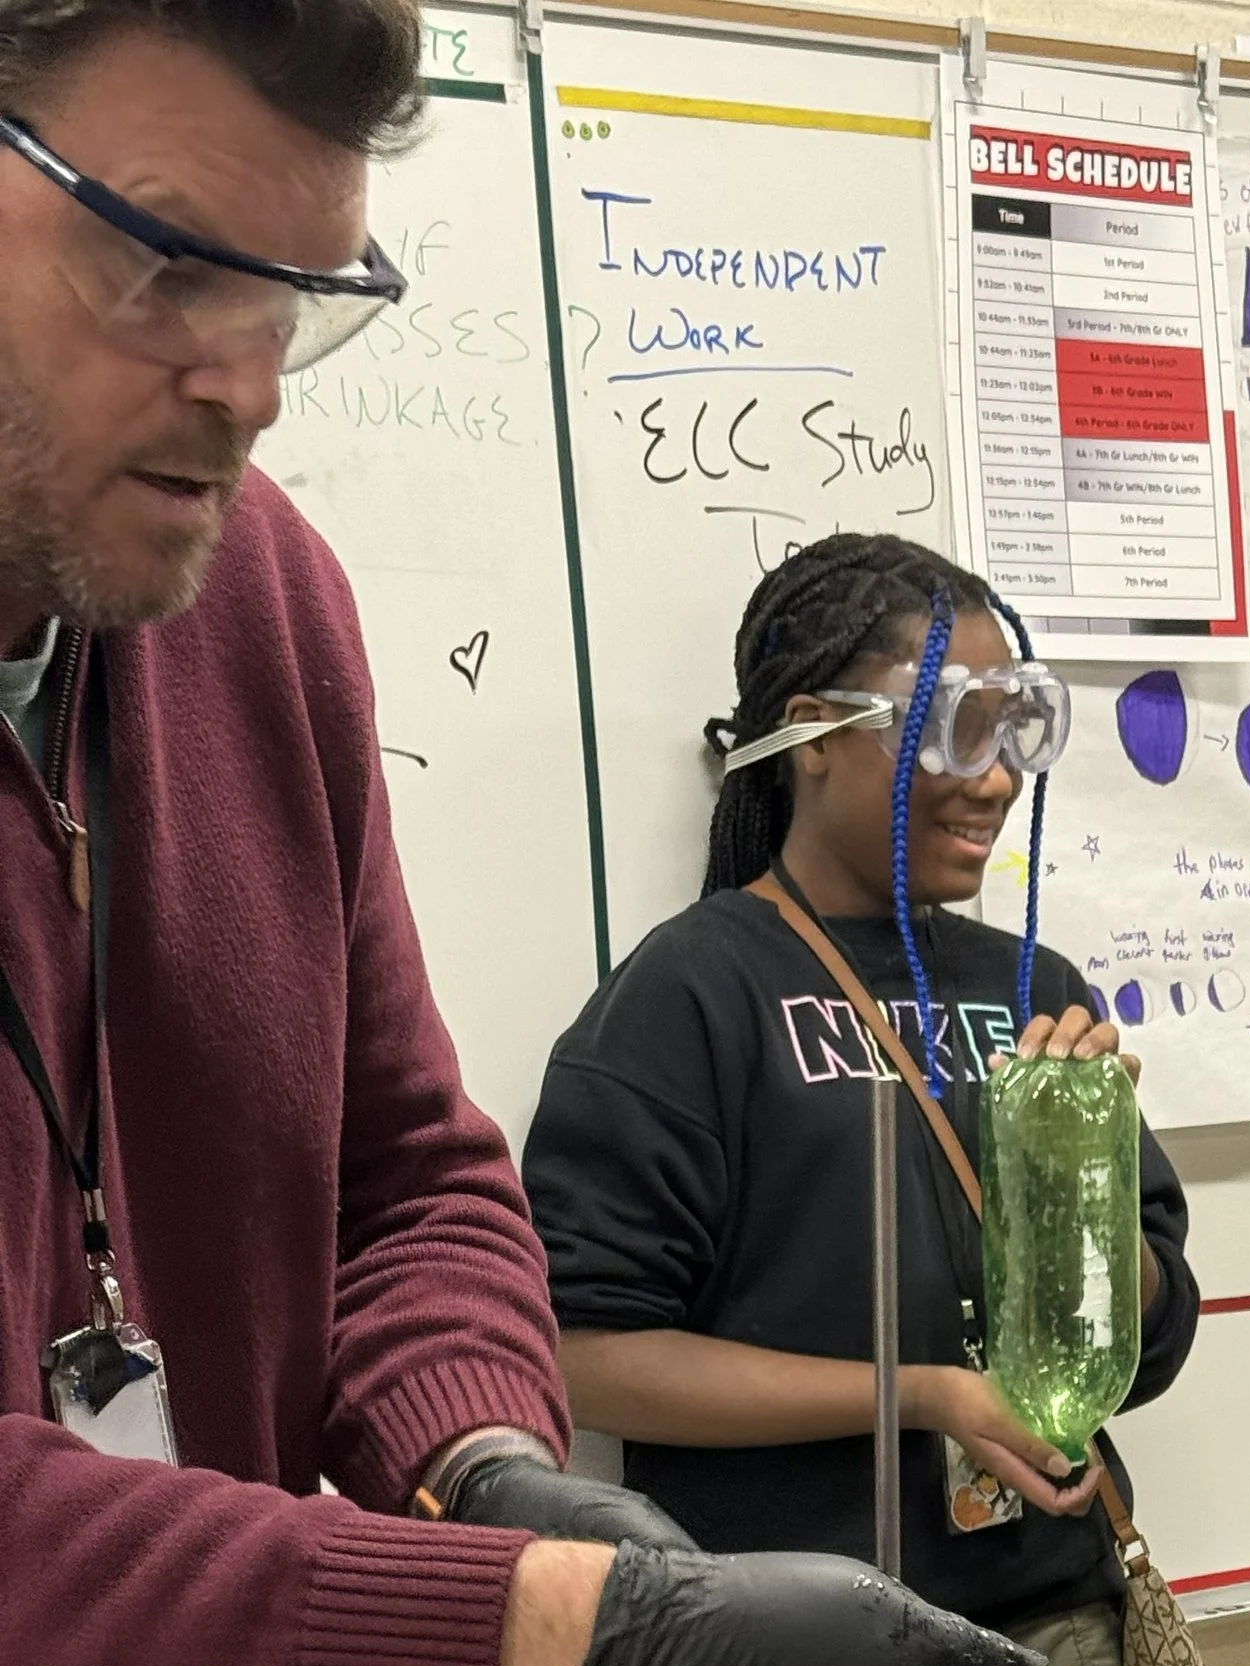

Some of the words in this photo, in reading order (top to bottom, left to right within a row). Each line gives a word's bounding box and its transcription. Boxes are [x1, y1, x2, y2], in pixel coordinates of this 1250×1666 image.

[969, 136, 1039, 177] BELL
[1047, 146, 1192, 195] SCHEDULE
[998, 208, 1024, 225] Time
[1106, 220, 1139, 235] Period
[581, 188, 887, 292] INDEPENDENT
[1104, 257, 1115, 268] 1st
[1117, 258, 1145, 271] Period
[1103, 290, 1119, 301] 2nd
[1121, 291, 1148, 303] Period
[1083, 320, 1111, 332] Period
[1164, 326, 1189, 337] ONLY
[1124, 354, 1150, 365] Grade
[1091, 417, 1119, 429] Period
[1142, 421, 1169, 431] Grade
[801, 399, 935, 516] Study
[1095, 448, 1109, 460] 7th
[1111, 450, 1121, 460] Gr
[1098, 480, 1111, 492] 7th
[1113, 481, 1124, 491] Gr
[1175, 484, 1201, 495] Lunch
[1120, 514, 1135, 525] 5th
[1136, 515, 1164, 526] Period
[1122, 545, 1137, 556] 6th
[1138, 545, 1166, 557] Period
[1125, 576, 1139, 587] 7th
[1140, 576, 1168, 589] Period
[1173, 845, 1200, 876] the
